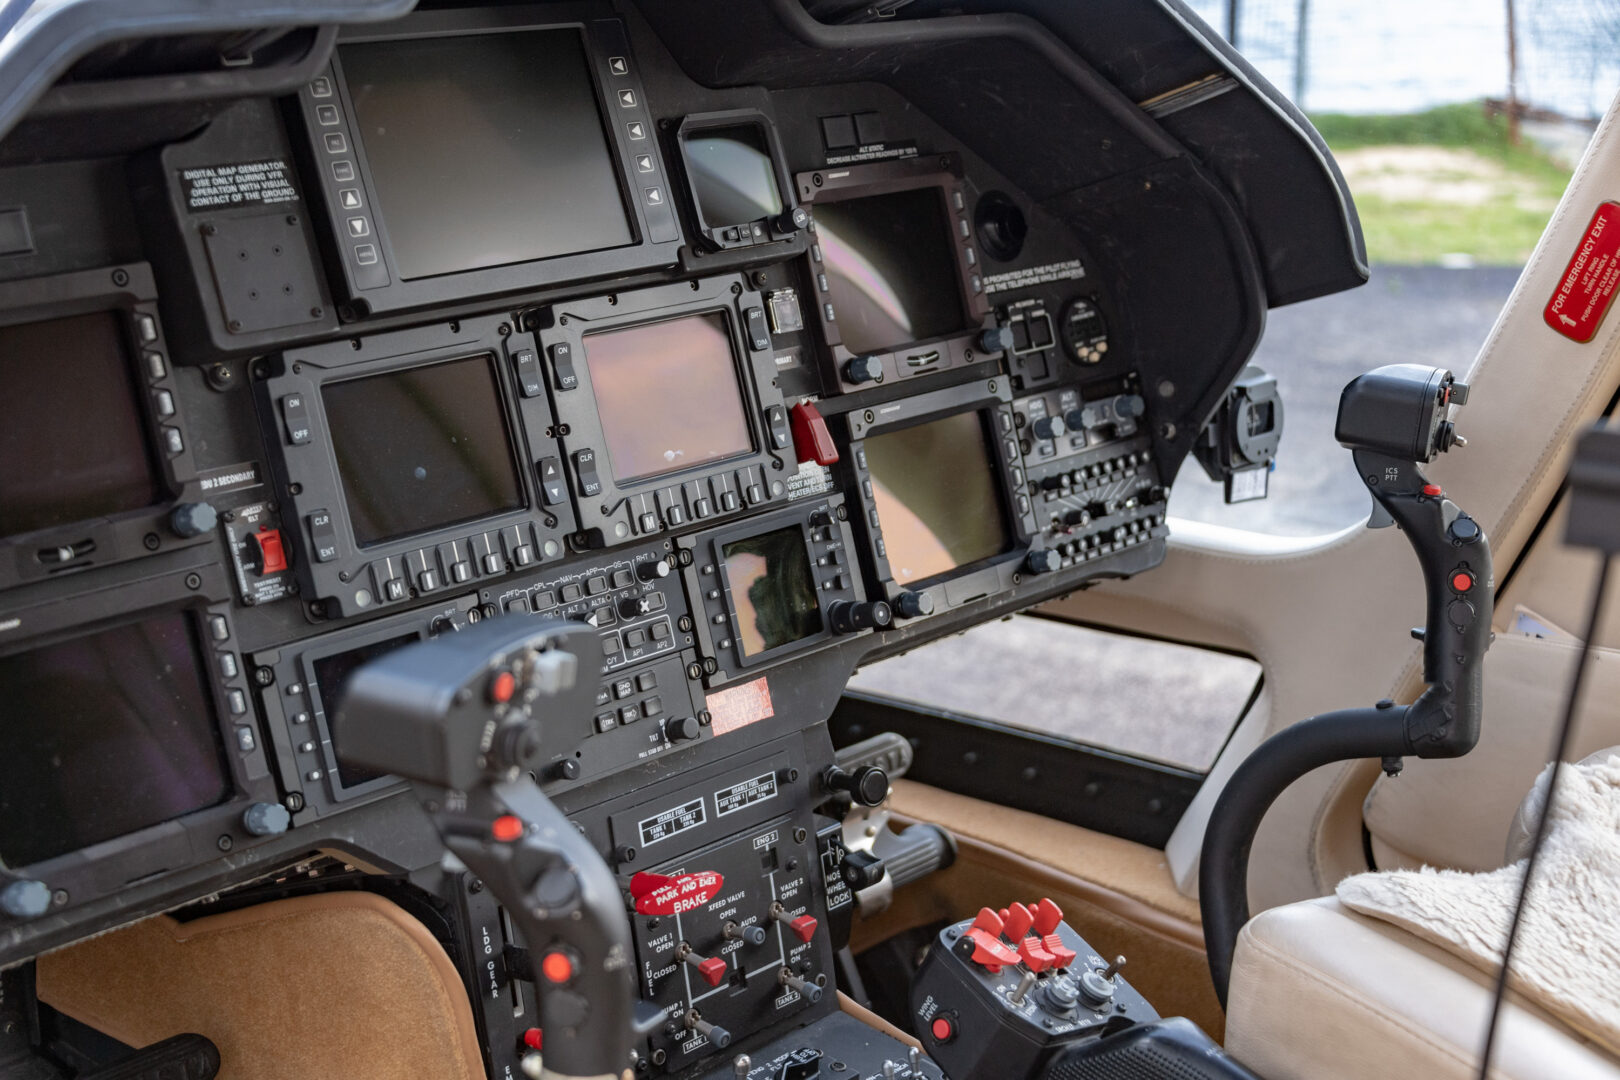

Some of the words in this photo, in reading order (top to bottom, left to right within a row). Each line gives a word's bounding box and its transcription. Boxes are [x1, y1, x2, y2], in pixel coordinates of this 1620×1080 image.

[184, 168, 217, 180] DIGITAL
[217, 166, 236, 176] MAP
[192, 179, 210, 188] USE
[212, 176, 234, 186] ONLY
[235, 172, 266, 183] DURING
[266, 170, 284, 179] VFR
[191, 184, 237, 197] OPERATION
[238, 182, 260, 192] WITH
[261, 179, 290, 189] VISUAL
[190, 194, 230, 207] CONTACT
[231, 193, 242, 202] OF
[244, 191, 260, 200] THE
[261, 187, 296, 198] GROUND
[1552, 294, 1566, 314] FOR
[1562, 237, 1596, 295] EMERGENCY
[1591, 215, 1608, 238] EXIT
[1581, 270, 1590, 286] LIFT
[1588, 256, 1599, 272] RING
[1584, 276, 1596, 294] TURN
[1594, 254, 1609, 278] HANDLE
[1581, 304, 1592, 322] PUSH
[1590, 288, 1601, 306] DOOR
[1598, 268, 1613, 288] CLEAR
[1610, 259, 1617, 270] OF
[751, 310, 762, 318] BRT
[520, 355, 532, 364] BRT
[563, 376, 575, 384] OFF
[289, 399, 299, 407] ON
[294, 430, 308, 439] OFF
[580, 454, 592, 462] CLR
[218, 470, 255, 486] SECONDARY
[586, 483, 598, 491] ENT
[314, 516, 329, 526] CLR
[645, 516, 655, 530] M
[320, 547, 335, 557] ENT
[636, 553, 648, 564] RHT
[586, 567, 598, 576] APP
[560, 574, 573, 583] NAV
[392, 582, 402, 596] M
[534, 580, 548, 590] CPL
[506, 588, 520, 599] PFD
[620, 590, 629, 598] VS
[567, 605, 579, 614] ALT
[657, 640, 668, 649] AP2
[632, 648, 643, 657] AP1
[607, 656, 618, 665] C/Y
[732, 784, 748, 795] USABLE
[748, 780, 759, 789] FUEL
[758, 784, 770, 793] TANK
[730, 795, 741, 804] TANK
[657, 810, 675, 823] USABLE
[675, 807, 686, 817] FUEL
[680, 814, 693, 823] TANK
[650, 826, 663, 835] TANK
[757, 836, 770, 846] ENG
[826, 870, 840, 883] NOS
[656, 889, 678, 906] PARK
[681, 881, 696, 894] AND
[699, 876, 716, 887] EMER
[780, 880, 798, 892] VALVE
[781, 889, 798, 900] OPEN
[830, 893, 849, 906] LOCK
[674, 891, 708, 914] BRAKE
[708, 900, 726, 912] XFEED
[727, 891, 745, 903] VALVE
[720, 908, 737, 920] OPEN
[741, 916, 757, 927] AUTO
[648, 936, 668, 948] VALVE
[656, 941, 674, 953] OPEN
[722, 940, 744, 955] CLOSED
[790, 944, 807, 956] PUMP
[790, 954, 801, 964] ON
[653, 964, 677, 979] CLOSED
[487, 961, 498, 998] GEAR
[646, 961, 654, 996] FUEL
[778, 996, 794, 1006] TANK
[918, 995, 933, 1016] WING
[664, 1004, 678, 1015] UMP
[673, 1009, 684, 1018] ON
[924, 1002, 938, 1022] LEVEL
[675, 1030, 687, 1040] OFF
[686, 1037, 704, 1051] TANK
